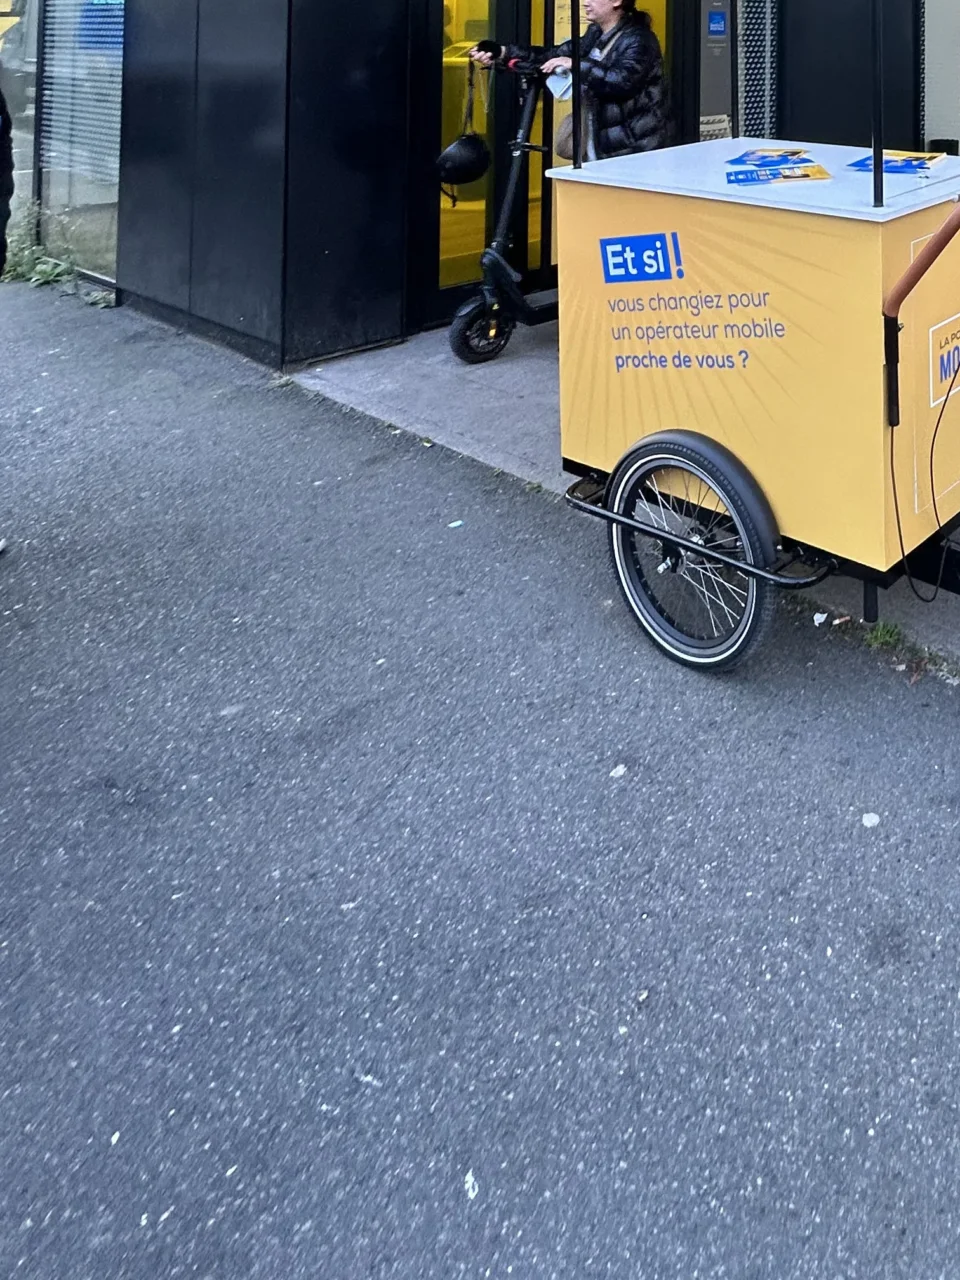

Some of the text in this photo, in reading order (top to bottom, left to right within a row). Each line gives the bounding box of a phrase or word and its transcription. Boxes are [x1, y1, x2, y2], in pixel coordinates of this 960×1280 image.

[605, 244, 638, 276] Et
[642, 240, 665, 274] si
[608, 290, 770, 317] vous changiez pour
[611, 317, 786, 345] un opérateur mobile
[939, 336, 950, 350] LA
[615, 349, 668, 373] proche
[672, 350, 692, 369] de
[695, 352, 735, 369] vous
